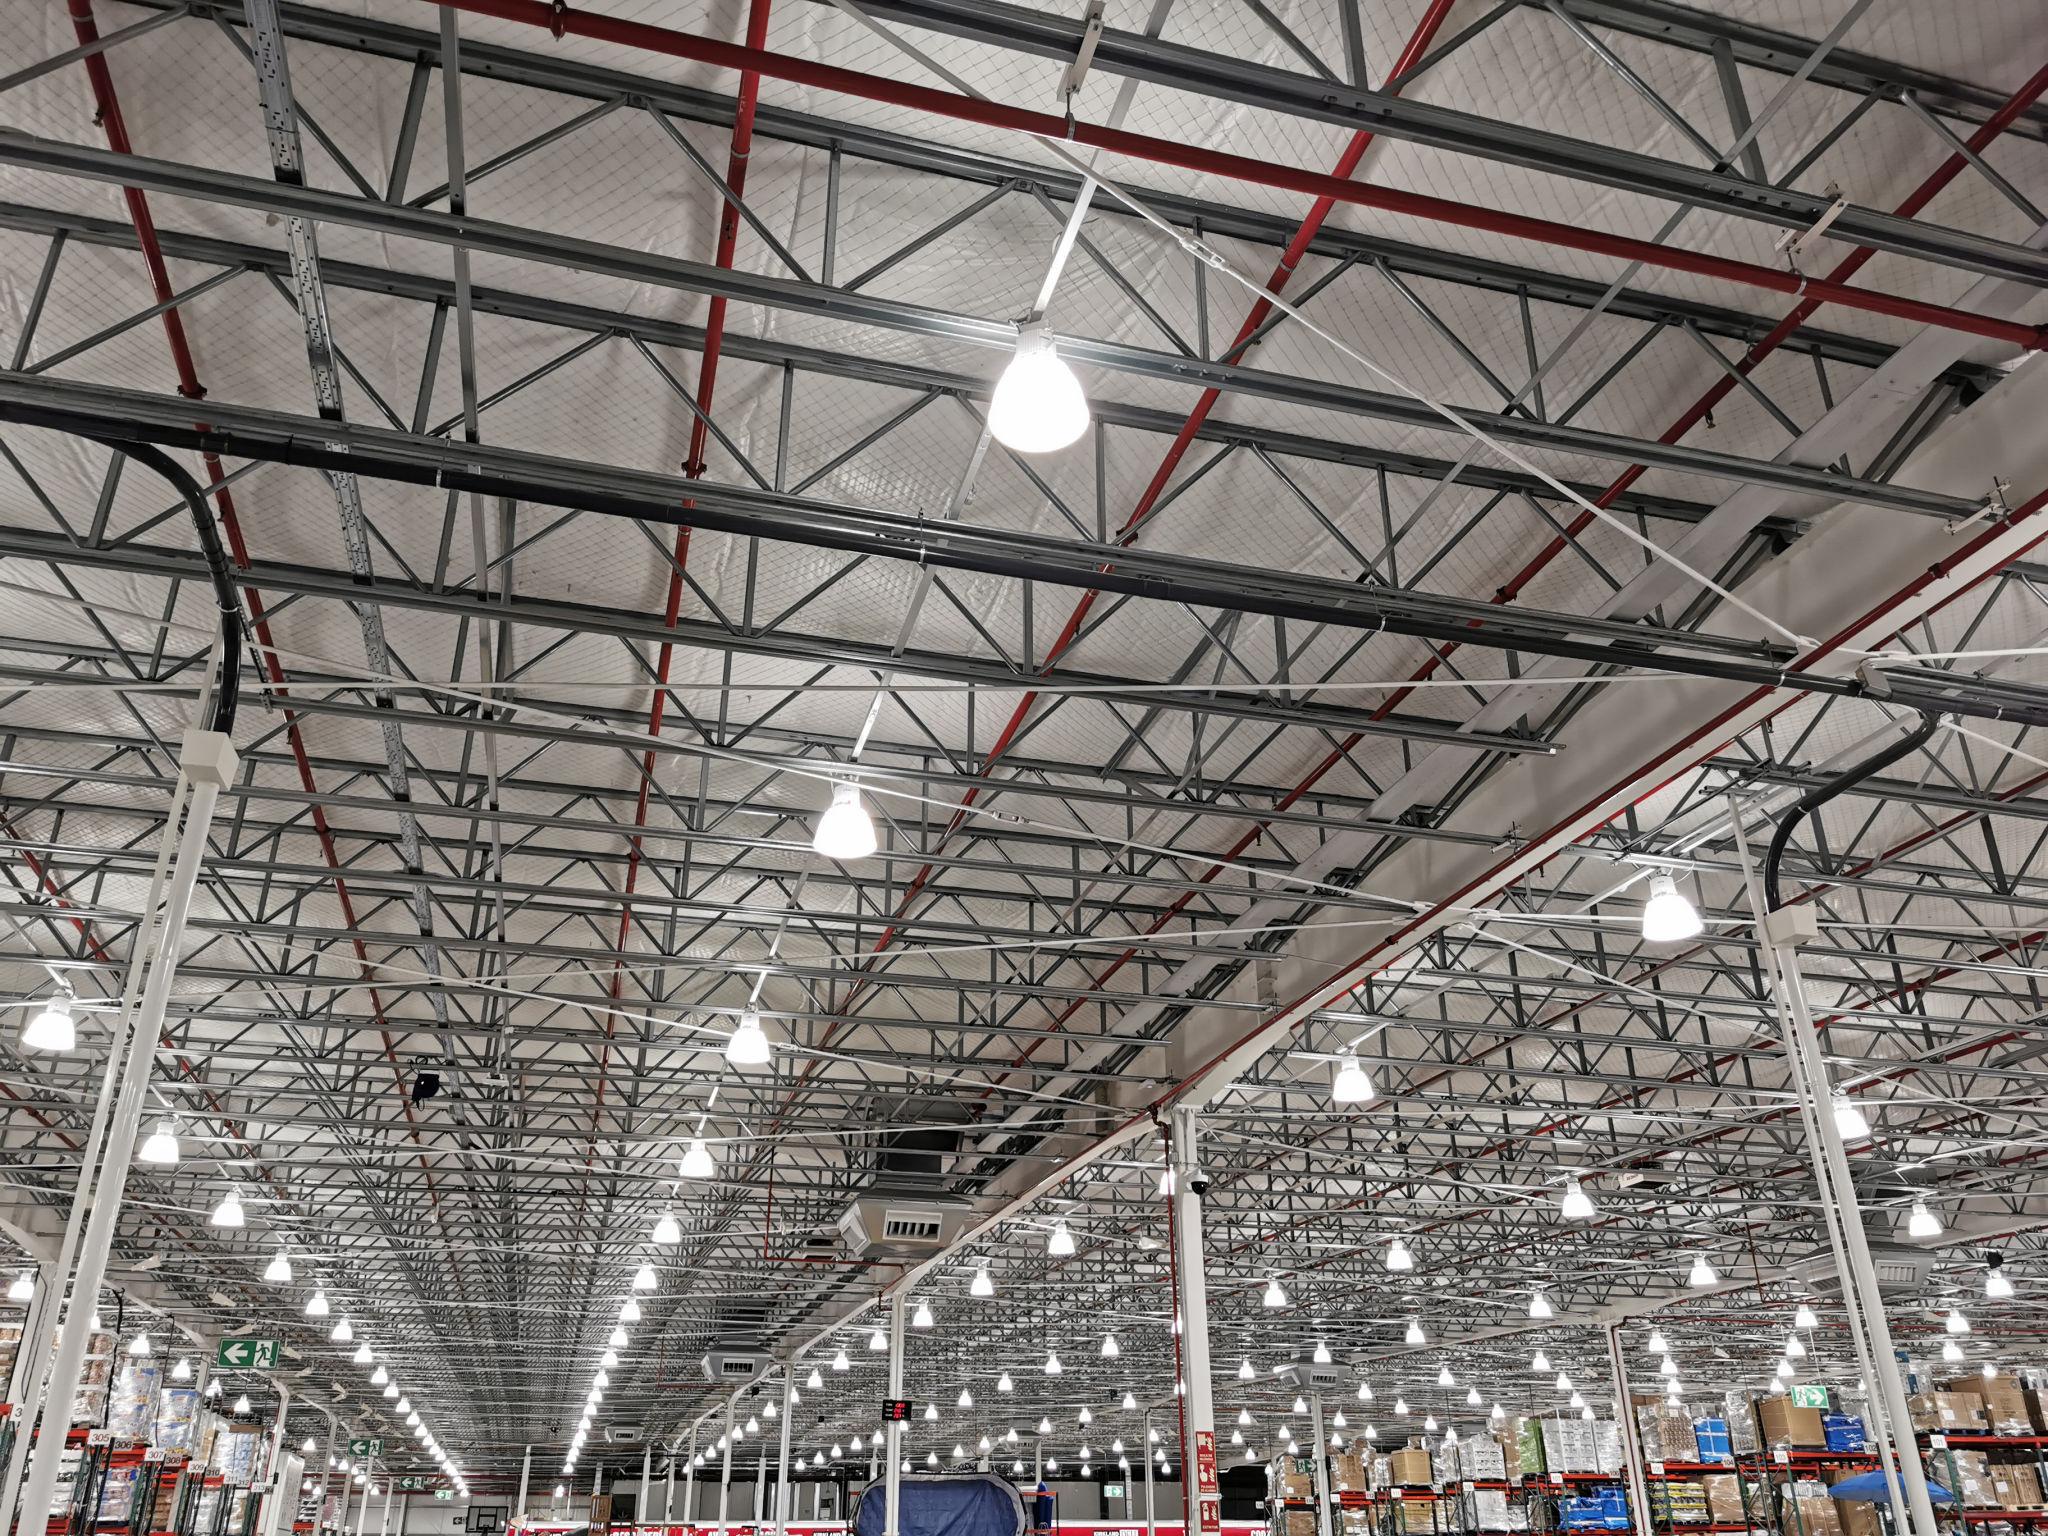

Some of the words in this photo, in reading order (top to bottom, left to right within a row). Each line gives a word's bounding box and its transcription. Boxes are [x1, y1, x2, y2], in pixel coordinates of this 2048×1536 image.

[92, 1433, 110, 1442] 305
[115, 1440, 132, 1449] 306
[1865, 1443, 1878, 1452] 102
[148, 1451, 163, 1459] 307
[165, 1456, 180, 1465] 308
